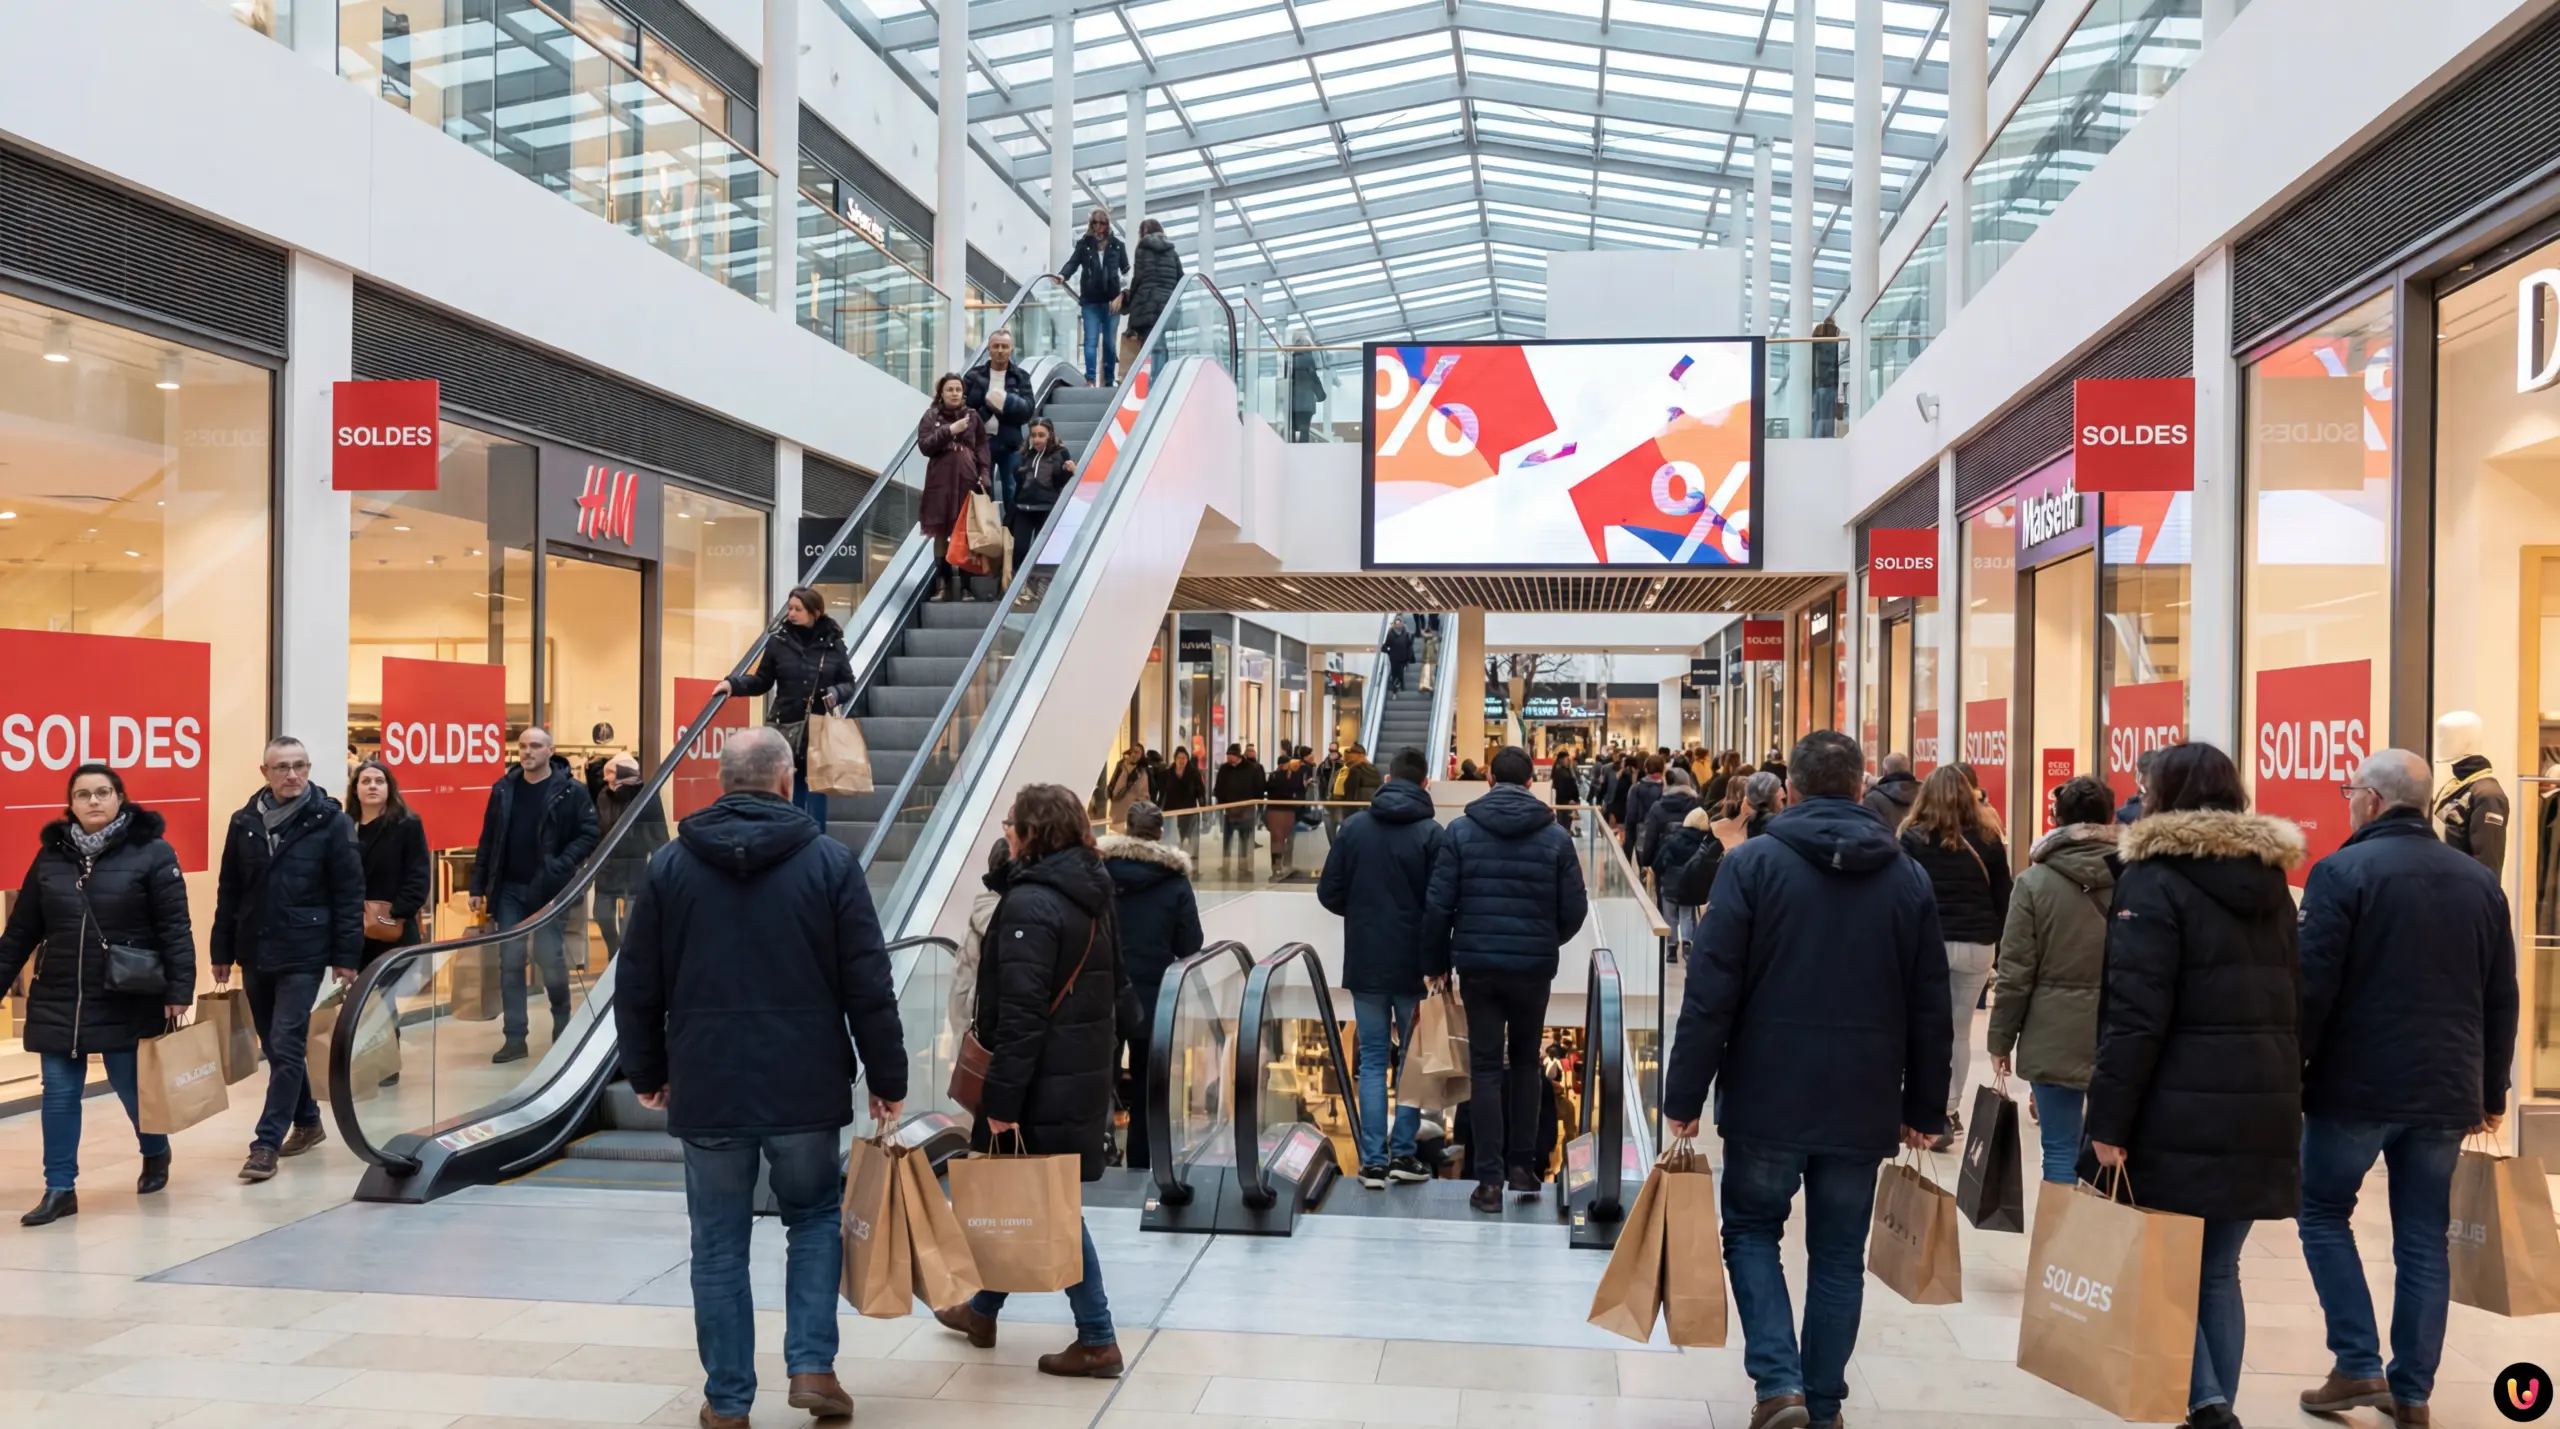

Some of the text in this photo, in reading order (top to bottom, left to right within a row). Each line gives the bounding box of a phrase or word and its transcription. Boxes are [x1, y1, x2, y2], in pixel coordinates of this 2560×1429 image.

[2517, 268, 2560, 393] D
[338, 426, 433, 446] SOLDES
[2082, 424, 2188, 446] SOLDES
[576, 464, 639, 547] H&M
[1874, 556, 1934, 570] SOLDES
[0, 713, 201, 772] SOLDES
[385, 721, 501, 766] SOLDES
[1966, 730, 2006, 766] SOLDES
[2260, 718, 2365, 781] SOLDES
[2042, 1264, 2113, 1312] SOLDES
